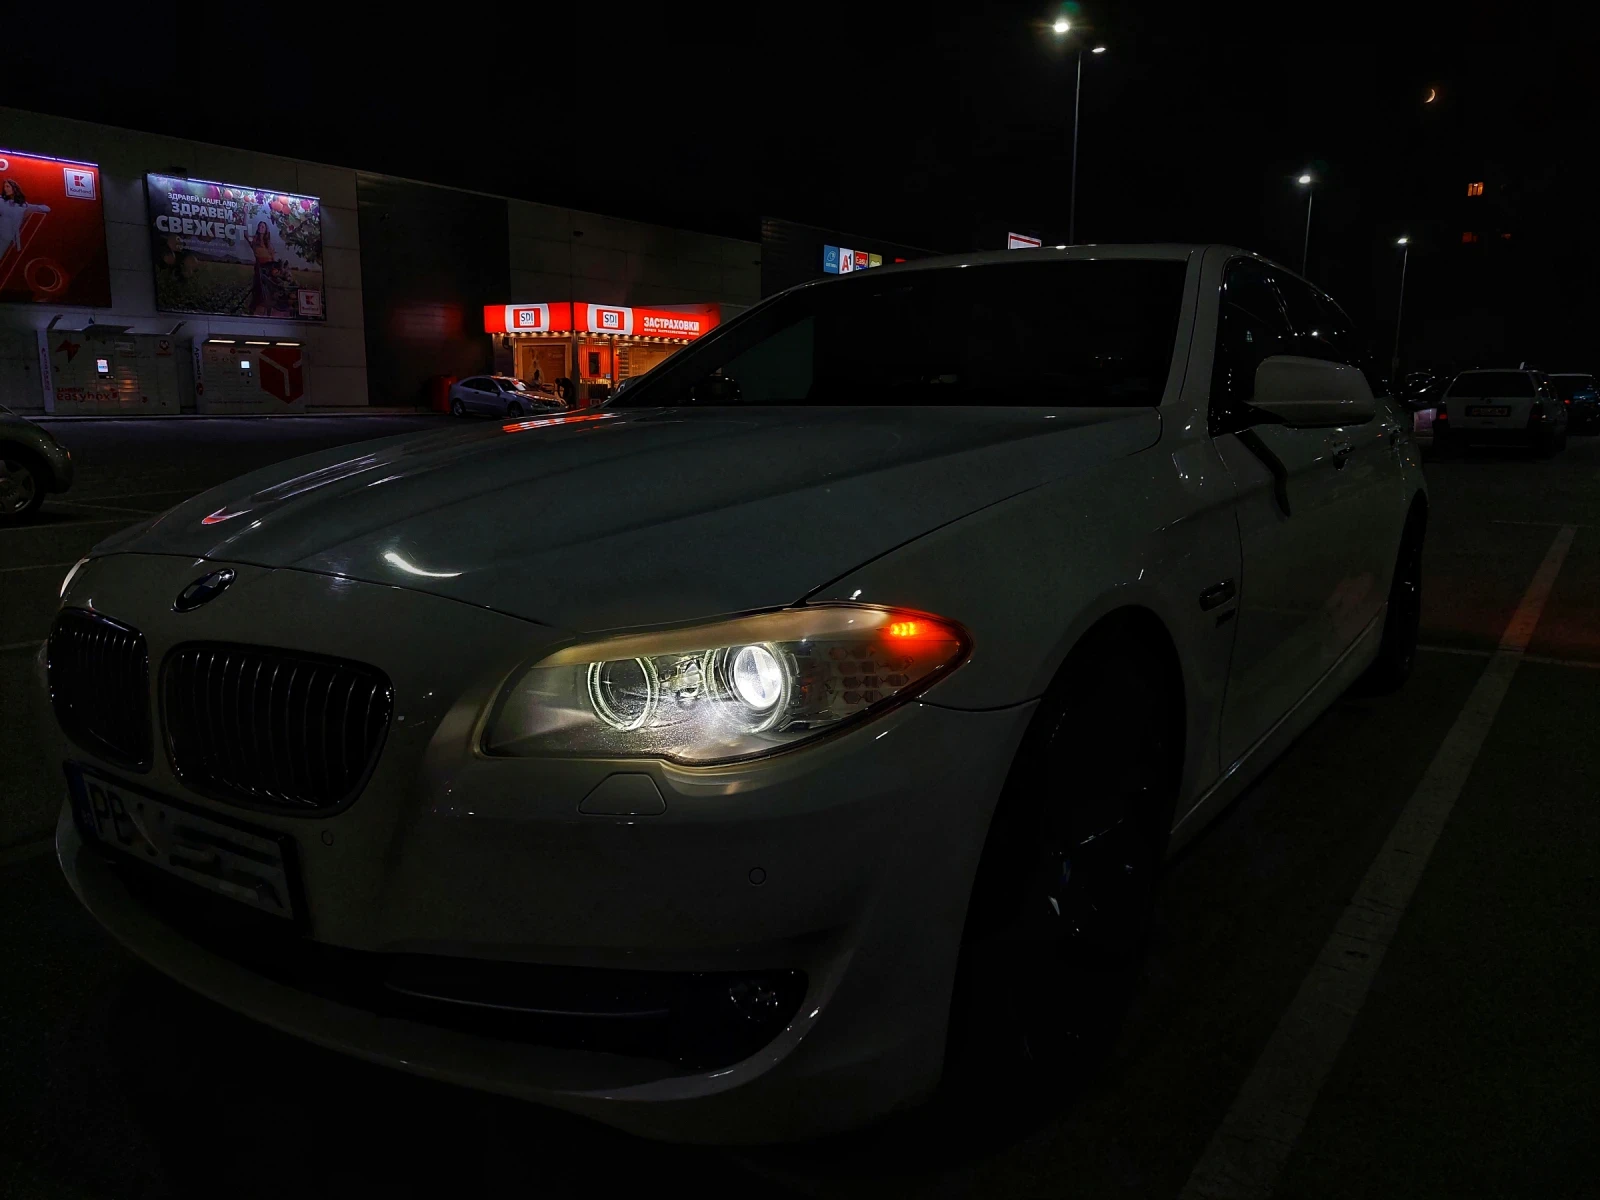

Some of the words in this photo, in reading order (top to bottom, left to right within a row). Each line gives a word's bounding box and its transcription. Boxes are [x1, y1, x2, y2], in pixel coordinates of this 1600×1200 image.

[171, 202, 236, 222] ЗДРАВЕЙ,
[156, 215, 254, 242] СВЕЖЕСТ!
[842, 253, 852, 271] A1
[520, 312, 534, 322] SDI
[604, 313, 617, 324] SDI
[643, 316, 700, 332] ЗАСТРАХОВКИ
[56, 391, 110, 402] easybox
